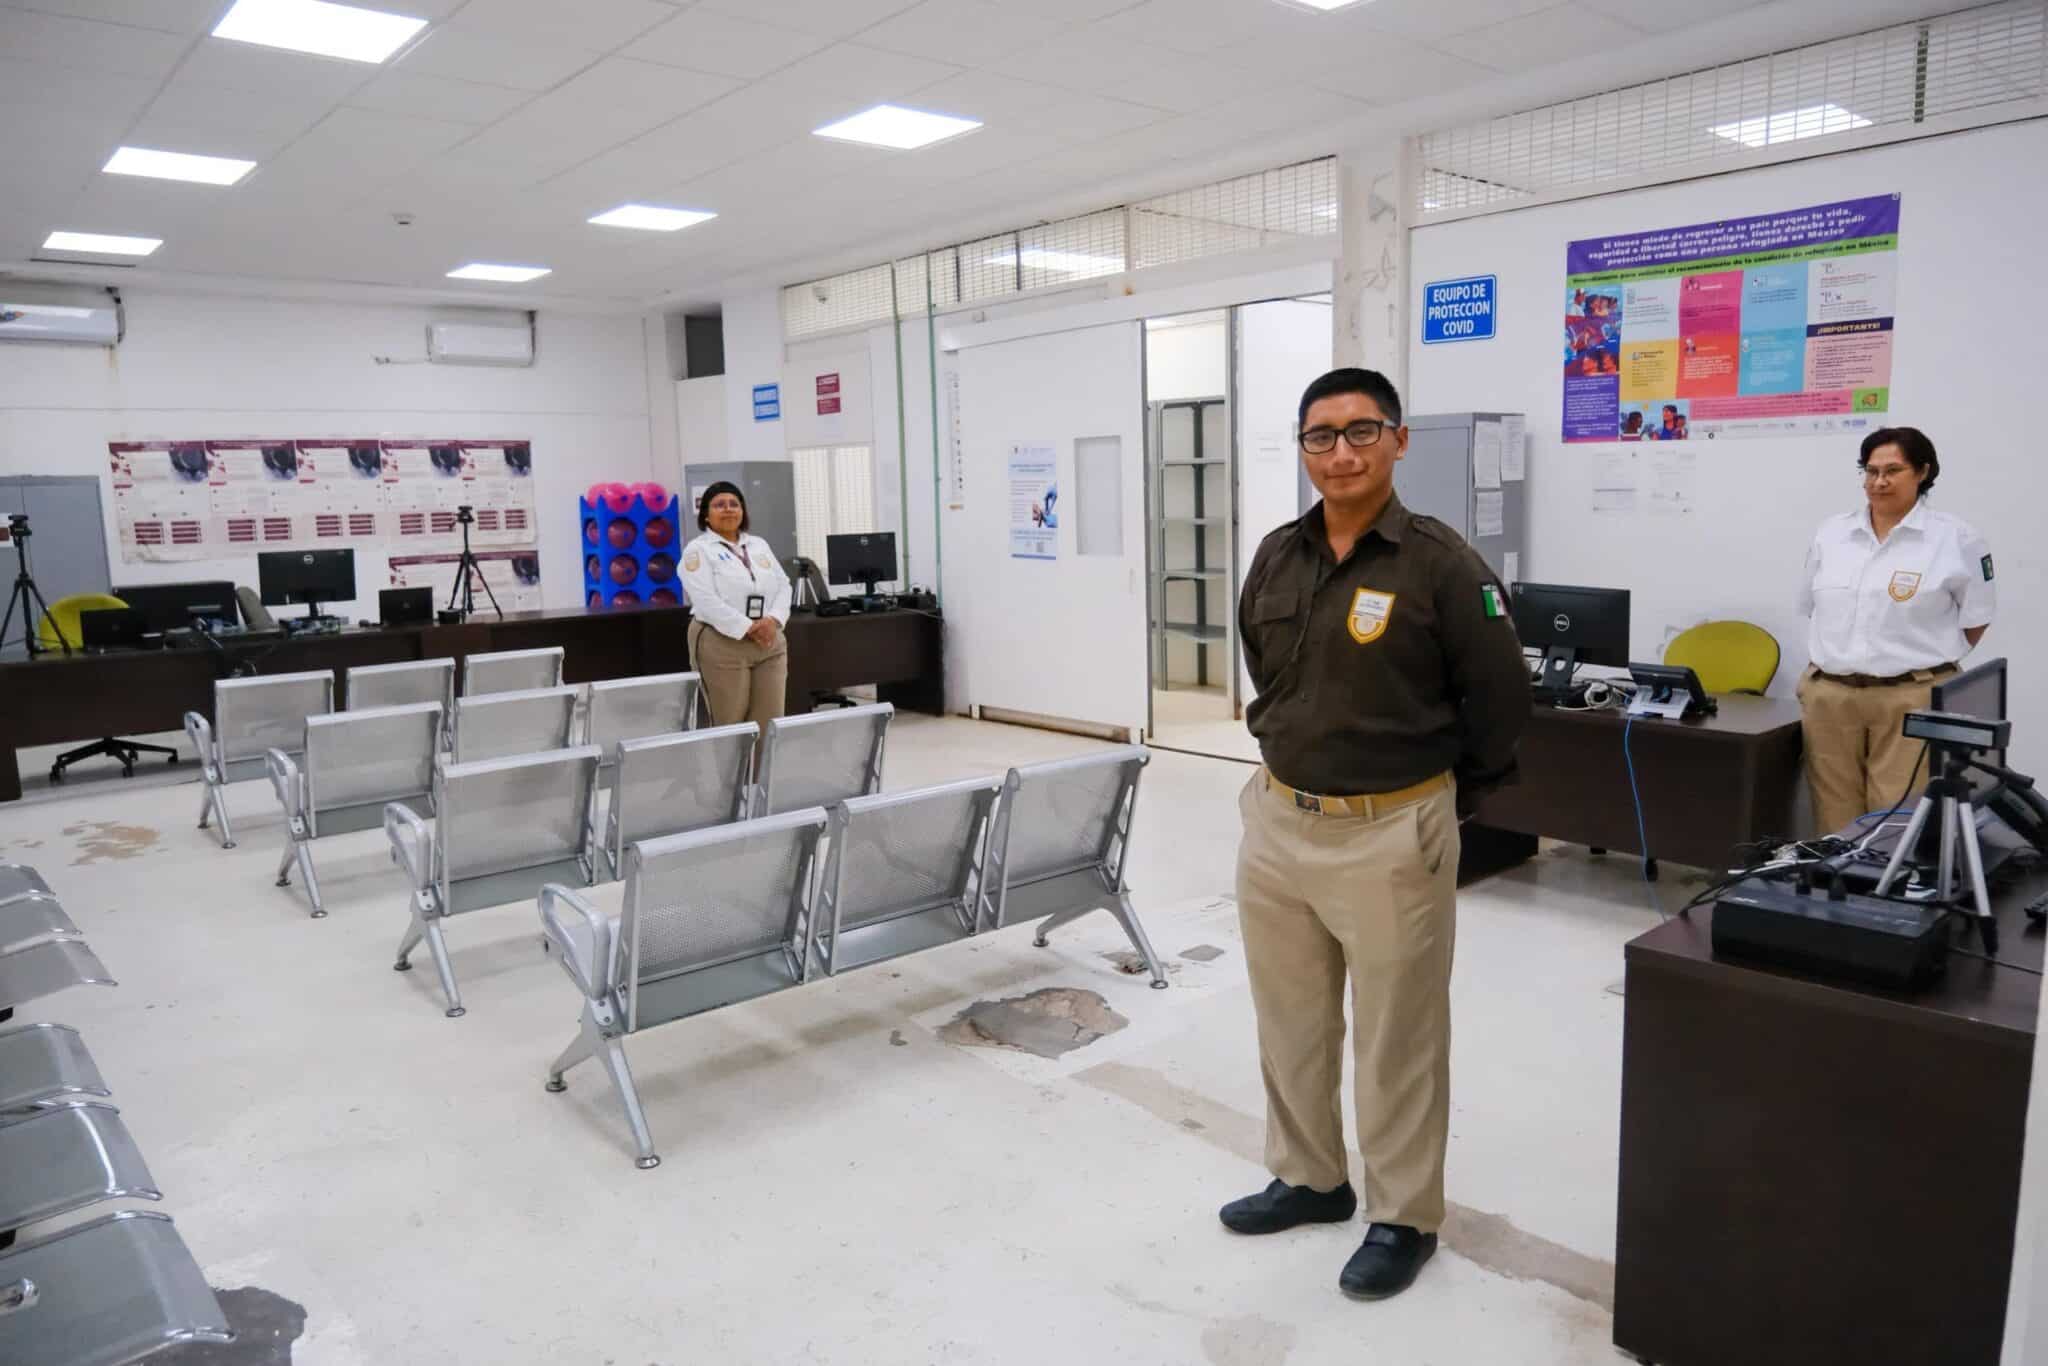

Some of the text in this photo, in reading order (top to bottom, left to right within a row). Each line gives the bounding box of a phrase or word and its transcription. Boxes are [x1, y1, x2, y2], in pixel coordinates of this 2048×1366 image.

[1588, 247, 1630, 260] seguridad
[1641, 242, 1677, 253] libertad
[1679, 238, 1709, 248] corren
[1751, 227, 1781, 238] tienes
[1785, 220, 1825, 233] derecho
[1838, 214, 1866, 226] pedir
[1614, 239, 1640, 248] tienes
[1643, 235, 1669, 245] miedo
[1672, 232, 1683, 241] de
[1686, 227, 1725, 239] regresar
[1773, 215, 1809, 227] porque
[1812, 212, 1823, 220] tu
[1607, 252, 1652, 266] protección
[1654, 250, 1678, 259] como
[1681, 248, 1697, 256] una
[1700, 243, 1738, 255] persona
[1741, 235, 1788, 248] refugiada
[1808, 227, 1845, 239] México
[1433, 283, 1486, 303] EQUIPO DE
[1428, 300, 1490, 320] PROTECCION
[1442, 320, 1475, 336] COVID
